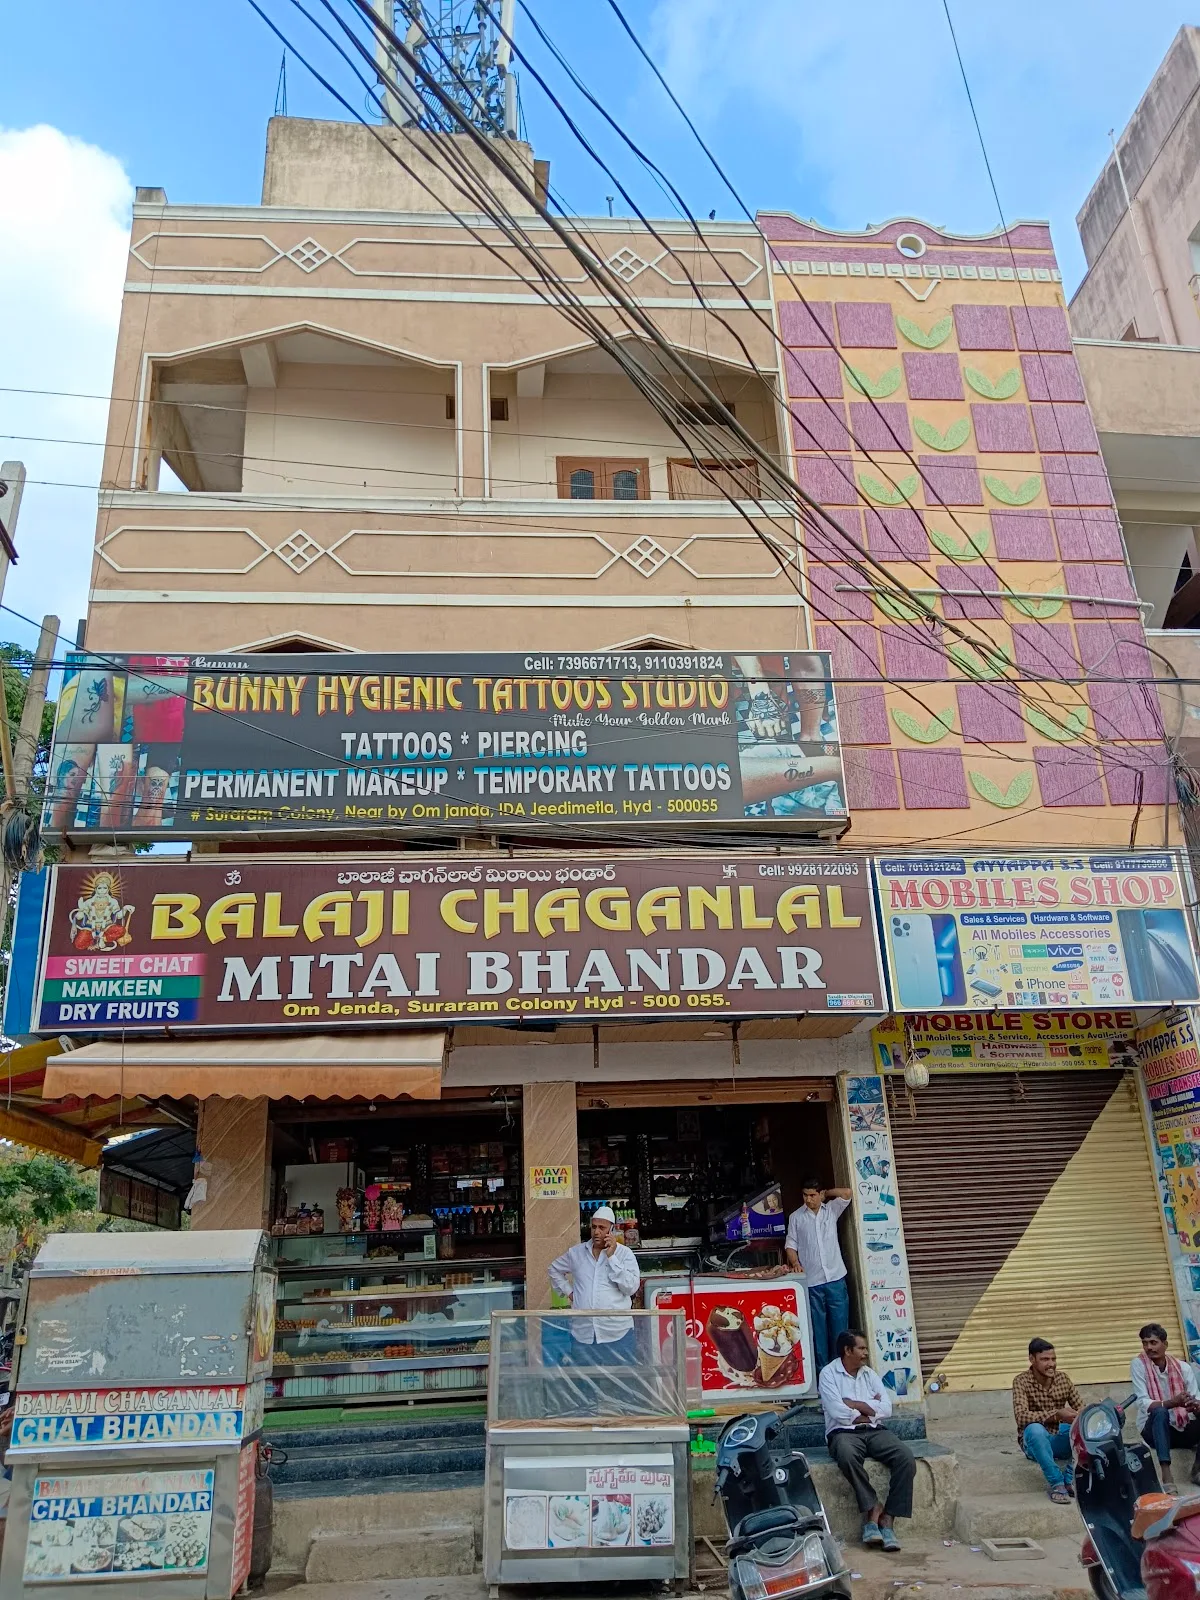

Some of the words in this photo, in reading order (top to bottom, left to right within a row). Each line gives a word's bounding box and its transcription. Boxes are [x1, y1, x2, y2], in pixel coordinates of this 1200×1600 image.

[524, 656, 554, 670] Cell:
[557, 656, 642, 673] 7396671713,
[645, 655, 724, 670] 9110391824
[192, 675, 306, 716] BUNNY
[317, 676, 464, 716] HYGIENIC
[473, 675, 613, 713] TATTOOS
[621, 674, 729, 711] STUDIO
[549, 713, 592, 728] Make
[595, 713, 633, 727] Your
[636, 712, 686, 727] Golden
[688, 712, 733, 727] Mark
[340, 732, 453, 761] TATTOOS
[477, 730, 588, 759] PIERCING
[184, 768, 340, 799] PERMANENT
[346, 767, 449, 797] MAKEUP
[473, 763, 617, 795] TEMPORARY
[623, 762, 732, 793] TATTOOS
[784, 765, 815, 781] Dad
[205, 807, 273, 822] Suraram
[279, 806, 339, 822] Colony,
[345, 804, 383, 819] Near
[388, 804, 408, 820] by
[412, 803, 440, 818] Om
[444, 802, 494, 820] janda,
[499, 802, 526, 816] IDA
[530, 800, 619, 817] Jeedimetla,
[623, 799, 652, 817] Hyd
[667, 798, 718, 813] 500055
[759, 864, 785, 876] Cell:
[788, 862, 859, 876] 9928122093
[885, 864, 906, 872] Cell:
[889, 876, 1060, 908] MOBILES
[1070, 875, 1175, 905] SHOP
[151, 889, 411, 948] BALAJI
[440, 884, 863, 940] CHAGANLAL
[963, 915, 985, 924] Sales
[986, 915, 993, 923] &
[994, 914, 1026, 923] Services
[1033, 913, 1069, 923] Hardware
[1070, 913, 1077, 921] &
[1078, 912, 1111, 921] Software
[972, 929, 988, 941] All
[990, 928, 1037, 940] Mobiles
[1039, 927, 1112, 939] Accessories
[64, 957, 136, 976] SWEET
[139, 955, 194, 974] CHAT
[217, 951, 441, 1003] MITAI
[466, 945, 827, 996] BHANDAR
[61, 979, 163, 998] NAMKEEN
[1027, 978, 1067, 990] iPhone
[59, 1002, 103, 1021] DRY
[106, 1001, 180, 1020] FRUITS
[283, 1003, 320, 1017] Om
[327, 1001, 401, 1017] Jenda,
[407, 999, 499, 1014] Suraram
[506, 997, 577, 1014] Colony
[585, 995, 624, 1011] Hyd
[643, 995, 682, 1008] 500
[687, 994, 731, 1007] 055.
[905, 1013, 1023, 1032] MOBILE
[1032, 1011, 1134, 1030] STORE
[925, 1034, 961, 1042] Mobiles
[988, 1033, 996, 1041] &
[1036, 1030, 1085, 1040] Accessories
[989, 1050, 1044, 1058] SOFTWARE
[1143, 1055, 1176, 1080] MOBILES
[1175, 1047, 1198, 1070] SHOP
[534, 1167, 568, 1177] MAVA
[535, 1176, 568, 1185] KULFI
[16, 1391, 98, 1416] BALAJI
[103, 1387, 244, 1413] CHAGANLAL
[17, 1416, 95, 1444] CHAT
[102, 1412, 238, 1441] BHANDAR
[32, 1498, 96, 1521] CHAT
[101, 1492, 211, 1516] BHANDAR
